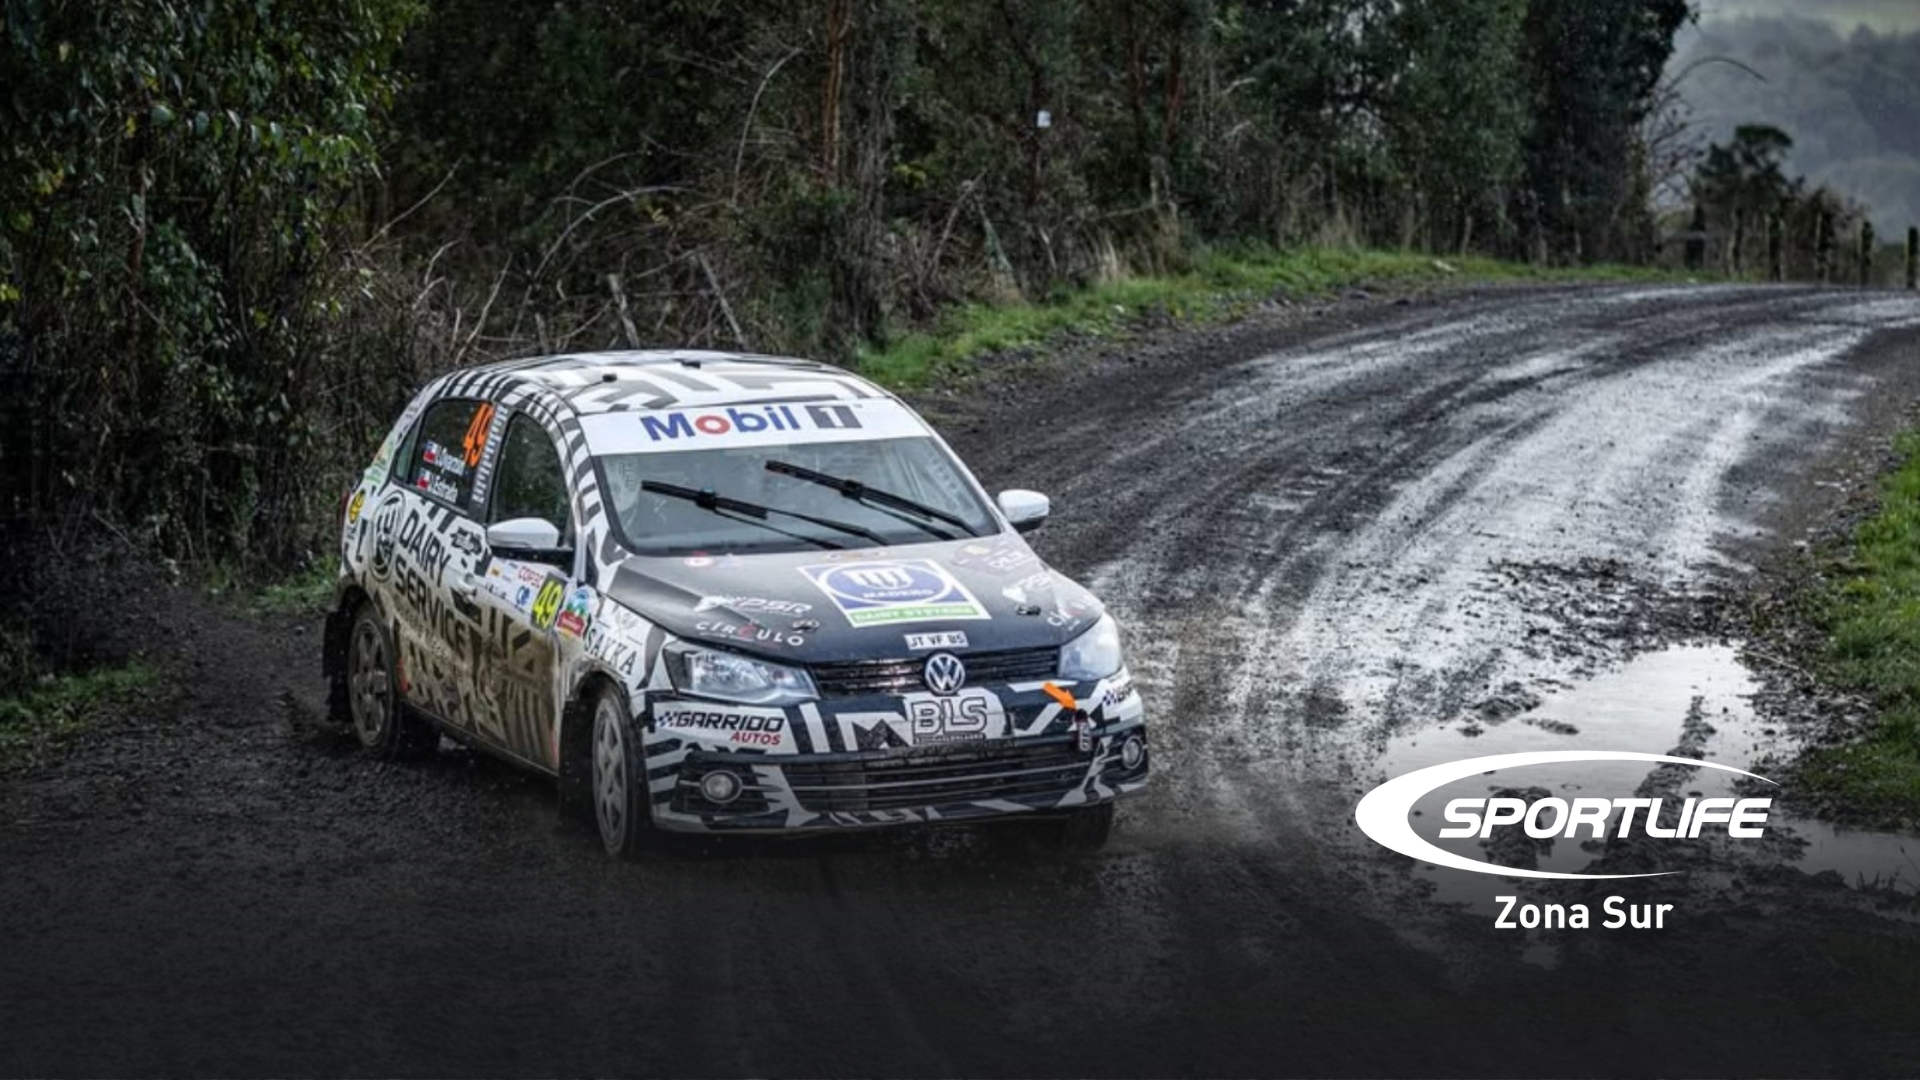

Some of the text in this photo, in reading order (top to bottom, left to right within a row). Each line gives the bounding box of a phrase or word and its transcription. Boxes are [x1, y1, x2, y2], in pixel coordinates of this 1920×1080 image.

[463, 403, 494, 467] 49
[640, 406, 802, 441] Mobil
[399, 508, 451, 588] DAIRY
[395, 552, 466, 662] SERVICE
[533, 579, 562, 629] 49
[672, 711, 785, 733] GARRIDO
[911, 697, 987, 734] BLS
[730, 731, 781, 746] AUTOS
